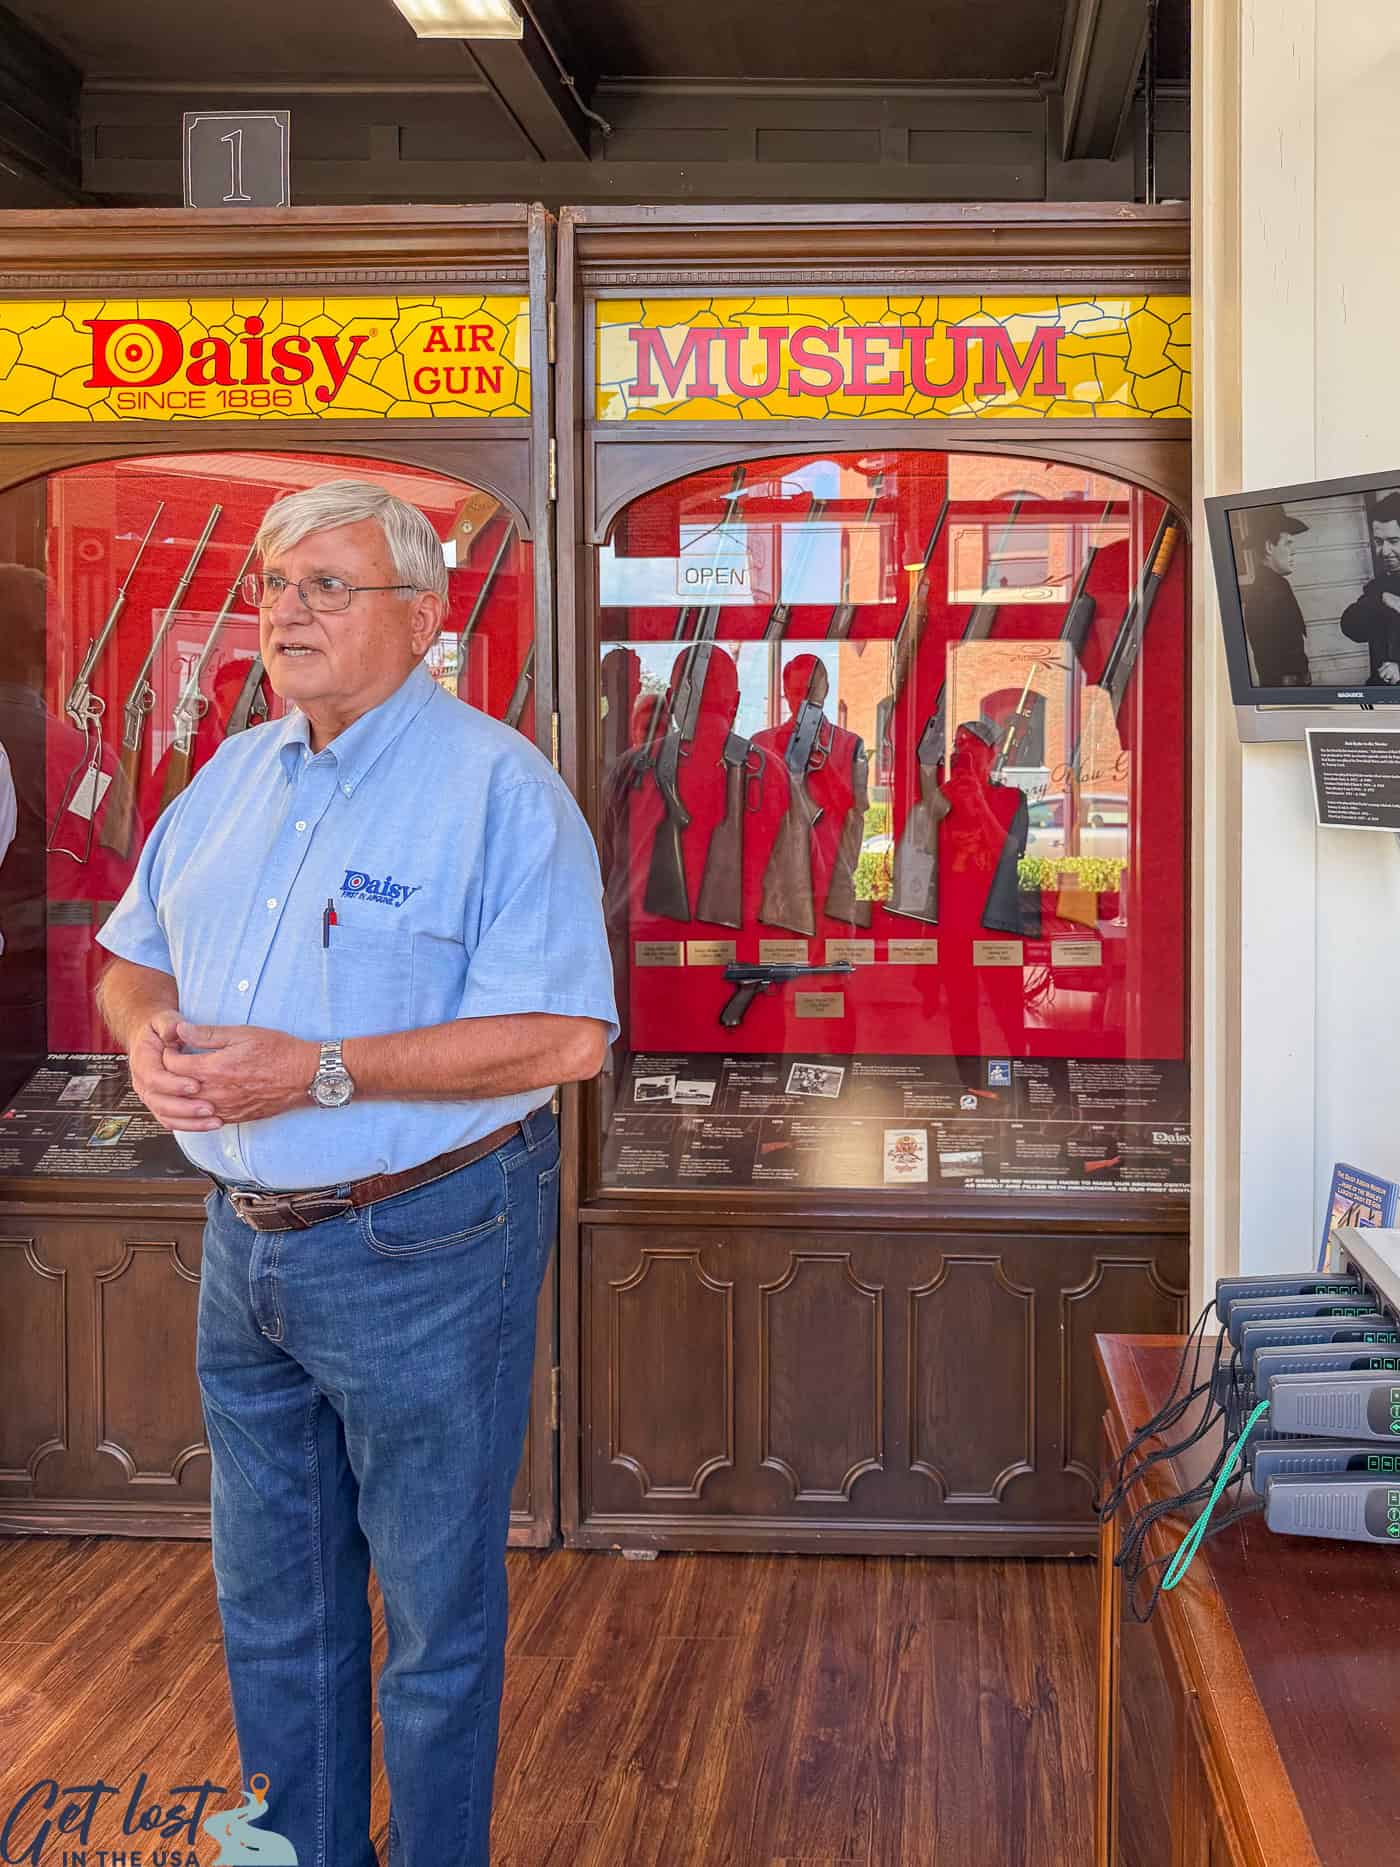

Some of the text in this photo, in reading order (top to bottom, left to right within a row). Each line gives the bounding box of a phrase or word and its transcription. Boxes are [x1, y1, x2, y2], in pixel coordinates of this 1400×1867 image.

[220, 129, 253, 202] 1
[423, 325, 496, 353] AIR
[82, 316, 369, 403] Daisy
[628, 326, 1067, 399] MUSEUM
[414, 366, 505, 396] GUN
[117, 389, 293, 410] SINCE 1886
[685, 567, 745, 586] OPEN
[340, 870, 422, 908] Daisy
